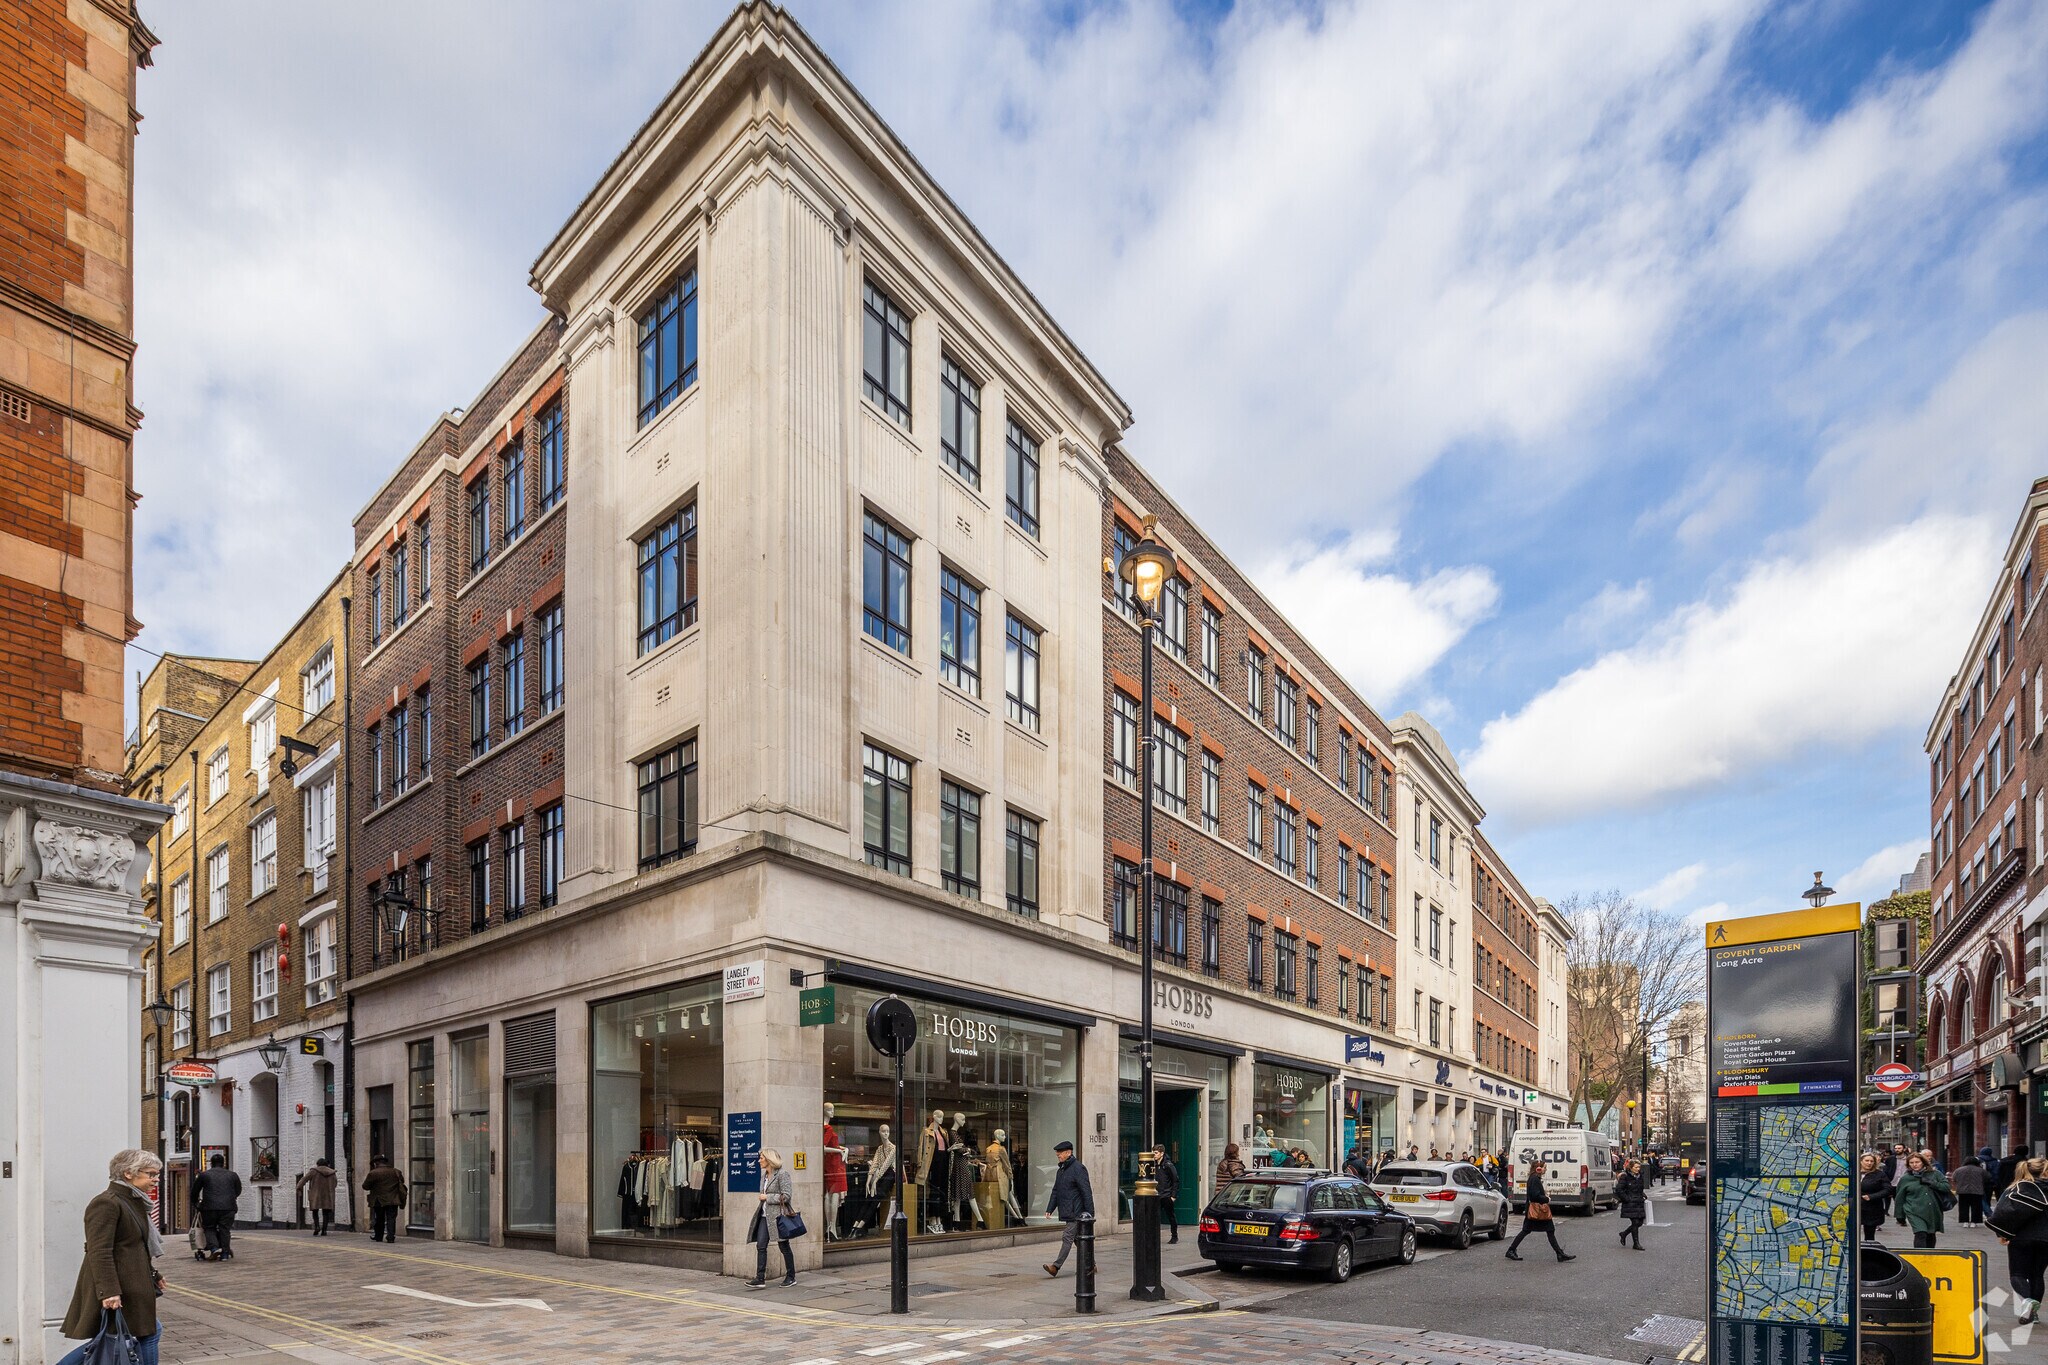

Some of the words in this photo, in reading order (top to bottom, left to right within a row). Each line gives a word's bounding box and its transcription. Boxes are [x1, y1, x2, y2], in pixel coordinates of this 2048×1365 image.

[1716, 949, 1756, 959] COVENT
[1759, 943, 1801, 955] GARDEN
[1716, 960, 1738, 968] Long
[1741, 957, 1763, 965] Acre
[727, 967, 750, 979] LANGLEY
[727, 979, 745, 990] STREET
[747, 976, 760, 986] WC2
[801, 998, 831, 1010] HOB
[1153, 980, 1213, 1019] HOBBS
[933, 1013, 997, 1044] HOBBS
[1171, 1019, 1195, 1030] LONDON
[304, 1039, 318, 1053] 5
[951, 1047, 978, 1056] LONDON
[1724, 1067, 1769, 1075] BLOOMSBURY
[1276, 1073, 1303, 1090] HOBBS
[1868, 1074, 1920, 1082] UNDERGROUND
[1089, 1135, 1108, 1143] HOBBS
[796, 1154, 805, 1167] H
[1541, 1150, 1578, 1163] CDL
[1253, 1158, 1268, 1169] SAL
[1236, 1224, 1252, 1233] LM56
